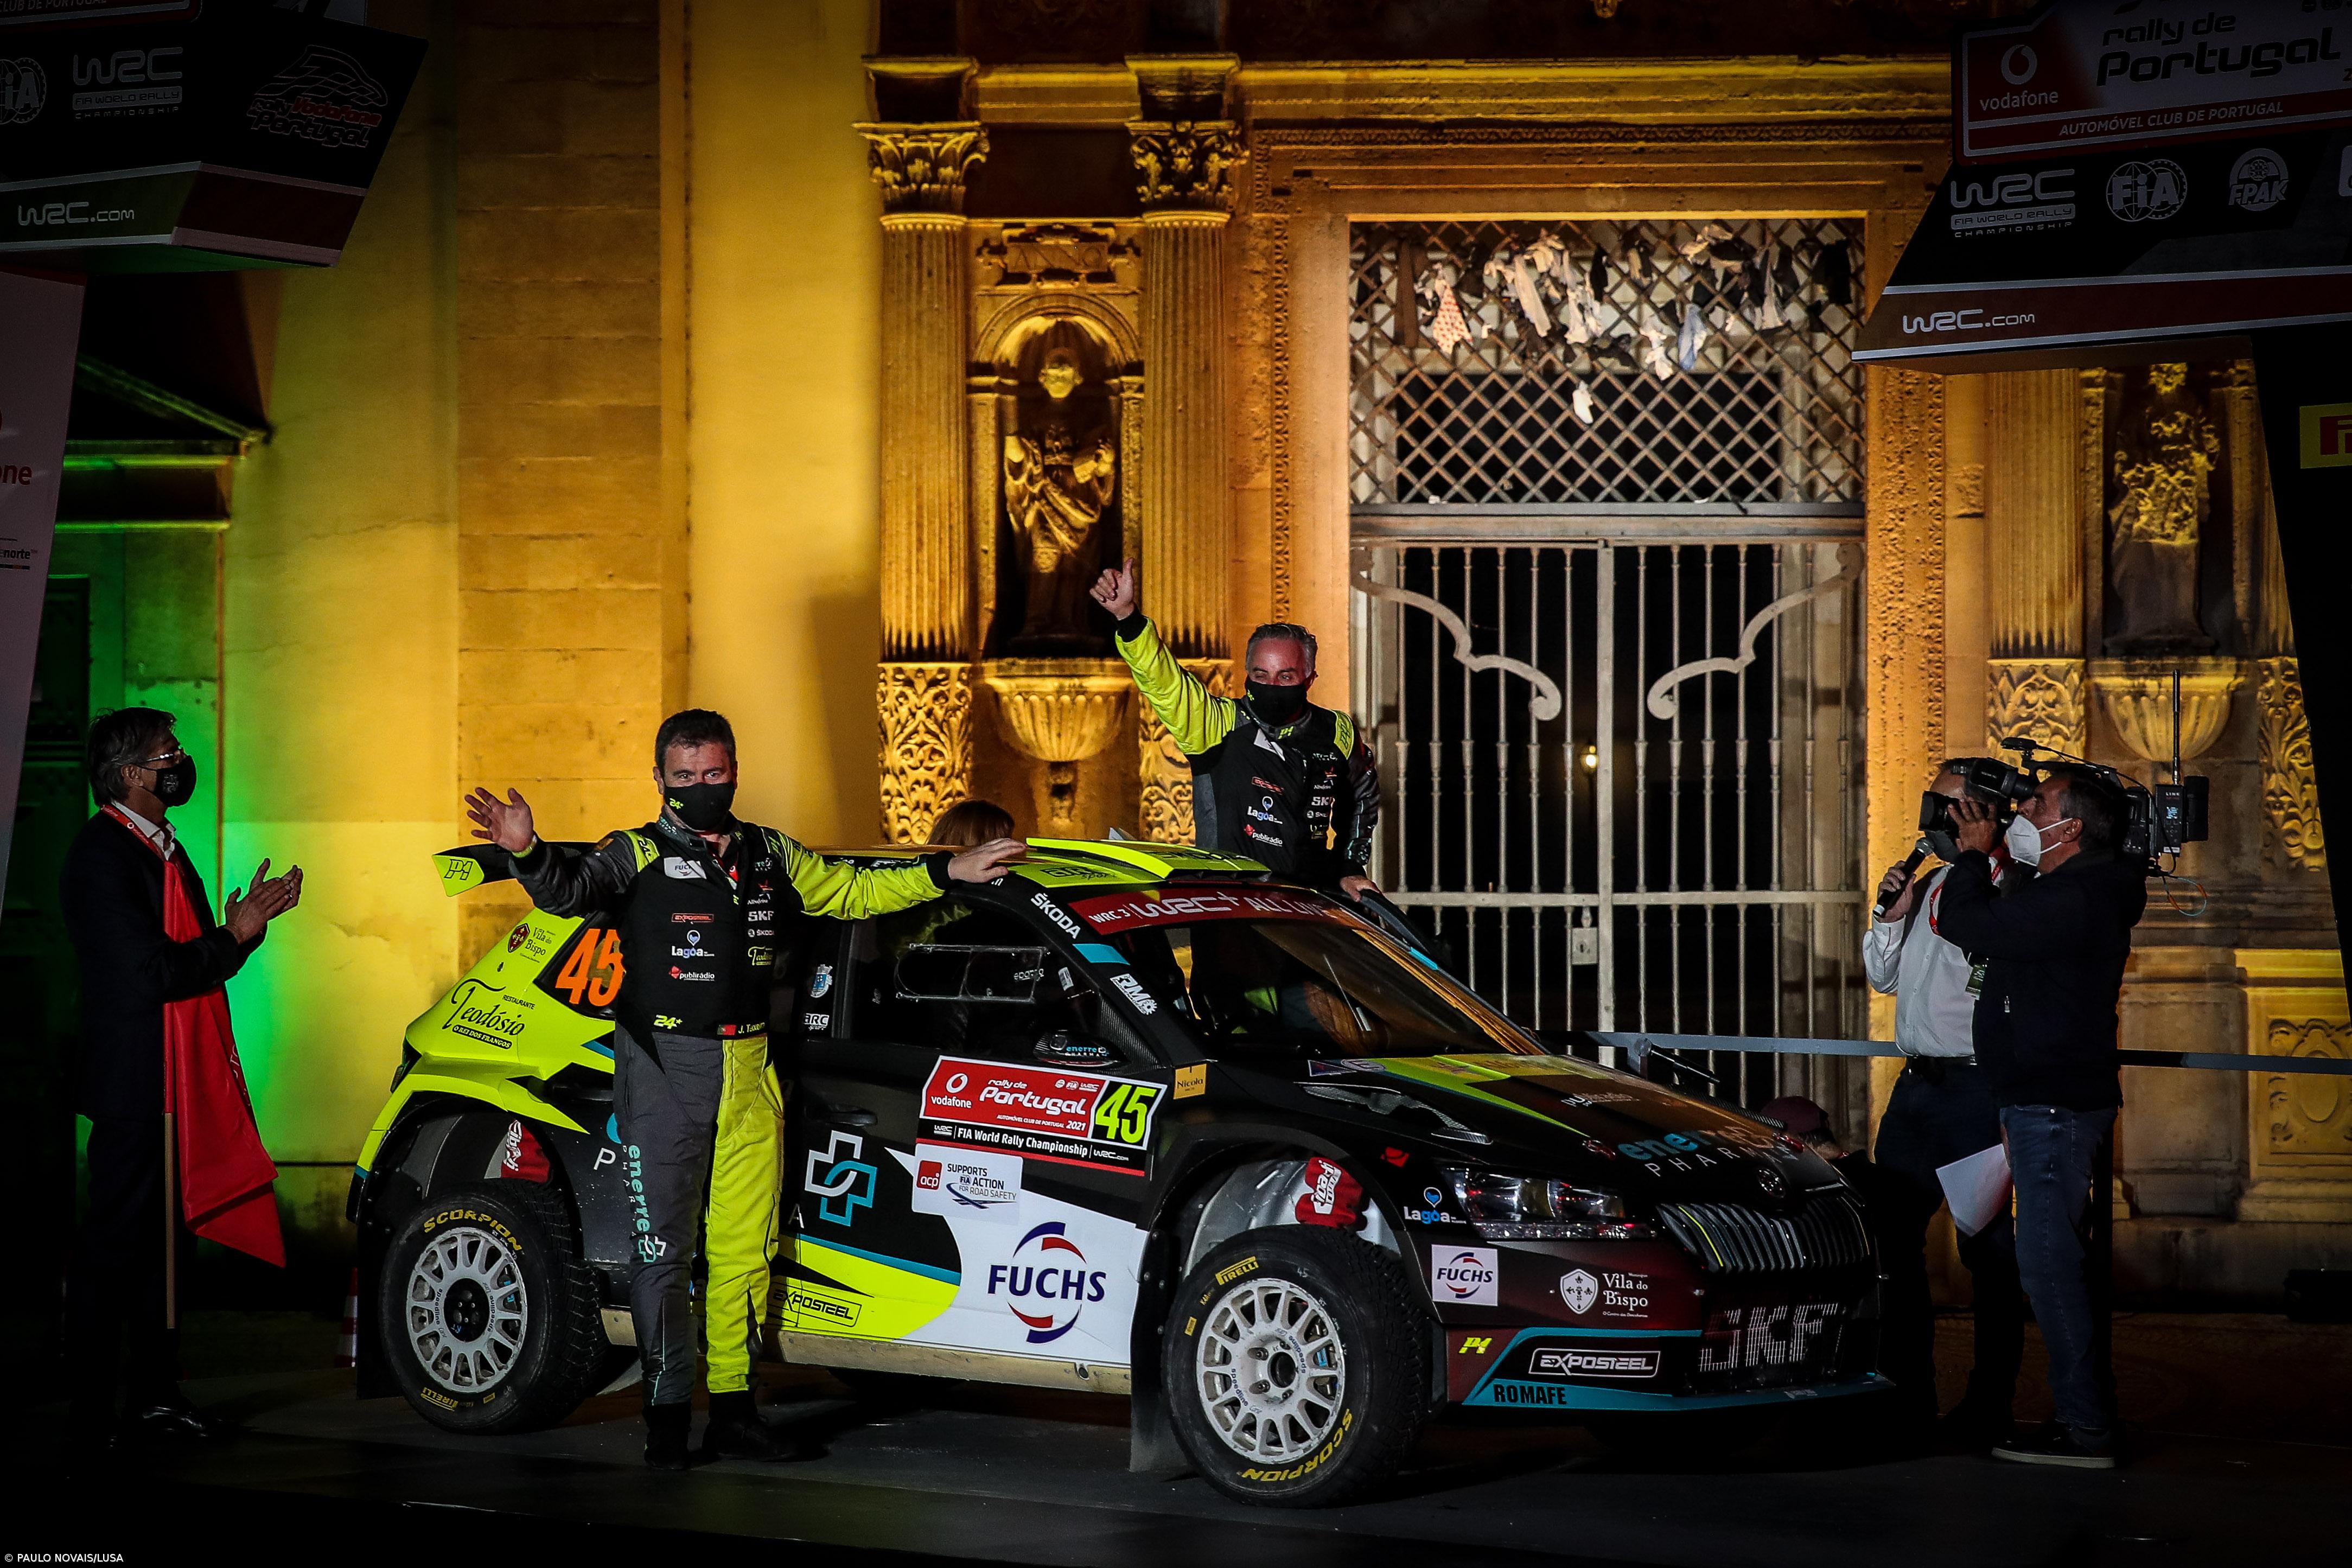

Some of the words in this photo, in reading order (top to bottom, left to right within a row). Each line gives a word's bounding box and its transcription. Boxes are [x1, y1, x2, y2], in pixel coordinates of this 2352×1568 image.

[2102, 18, 2184, 46] rally
[2192, 12, 2236, 35] de
[72, 47, 183, 86] WRC
[2096, 27, 2341, 86] Portugal
[75, 97, 92, 105] FIA
[95, 94, 136, 104] WORLD
[139, 91, 180, 101] RALLY
[1979, 90, 2058, 112] vodafone
[75, 106, 180, 120] CHAMPIONSHIP
[2059, 114, 2143, 137] AUTOMÓVEL
[2147, 110, 2183, 127] CLUB
[2187, 109, 2204, 122] DE
[2208, 101, 2283, 119] PORTUGAL
[247, 107, 371, 148] Portugal
[1951, 168, 2075, 208] WRC
[2227, 178, 2290, 206] FPAK
[18, 201, 135, 226] WRC.com
[1954, 217, 1973, 226] FIA
[1977, 212, 2023, 223] WORLD
[2026, 207, 2073, 219] RALLY
[1954, 221, 2073, 238] CHAMPIONSHIP
[1903, 308, 2035, 334] WRC.com
[1247, 805, 1274, 822] Lagoa
[1242, 897, 1292, 913] ALL
[748, 910, 774, 922] SKF
[1030, 891, 1081, 940] ŠKODA
[1088, 910, 1122, 923] WRC
[1120, 908, 1131, 918] 3
[533, 927, 546, 942] Vila
[525, 939, 546, 957] Bispo
[671, 945, 703, 959] Lagoa
[554, 927, 624, 1007] 45
[679, 971, 715, 980] publirádio
[442, 979, 525, 1036] Teodósio
[502, 995, 536, 1010] RESTAURANTE
[653, 1014, 678, 1030] 24
[481, 1034, 511, 1048] FRANGOS
[1066, 1045, 1098, 1053] enerre
[987, 1079, 1014, 1089] rally
[1014, 1081, 1028, 1089] de
[1177, 1077, 1203, 1089] Nicola
[930, 1095, 972, 1109] vodafone
[979, 1086, 1087, 1116] Portugal
[996, 1114, 1023, 1123] AUTOMÓVEL
[1041, 1120, 1065, 1128] PORTUGAL
[1094, 1084, 1158, 1144] 45
[1066, 1120, 1087, 1131] 2021
[957, 1127, 972, 1139] FIA
[974, 1130, 999, 1143] World
[1002, 1134, 1024, 1148] Rally
[1026, 1137, 1088, 1158] Championship
[1093, 1148, 1129, 1162] WRC.com
[947, 1163, 987, 1177] SUPPORTS
[628, 1144, 651, 1232] enerre
[920, 1175, 939, 1188] acp
[960, 1176, 971, 1185] FIA
[972, 1176, 1005, 1190] ACTION
[970, 1187, 989, 1197] ROAD
[990, 1190, 1017, 1200] SAFETY
[1404, 1208, 1451, 1225] Lagoa
[423, 1209, 525, 1252] SCORPION
[1215, 1255, 1260, 1286] PIRELLI
[1437, 1268, 1494, 1283] FUCHS
[987, 1264, 1107, 1302] FUCHS
[1602, 1273, 1634, 1290] Vila
[1636, 1280, 1648, 1290] do
[435, 1287, 443, 1325] speedline
[773, 1289, 853, 1320] EXPOSTEEL
[1603, 1290, 1648, 1311] Bispo
[487, 1295, 496, 1333] speedline
[1287, 1335, 1306, 1374] speedline
[1539, 1353, 1654, 1376] EXPOSTEEL
[1231, 1368, 1249, 1407] speedline
[1494, 1384, 1566, 1405] ROMAFE
[1241, 1408, 1354, 1482] SCORPION
